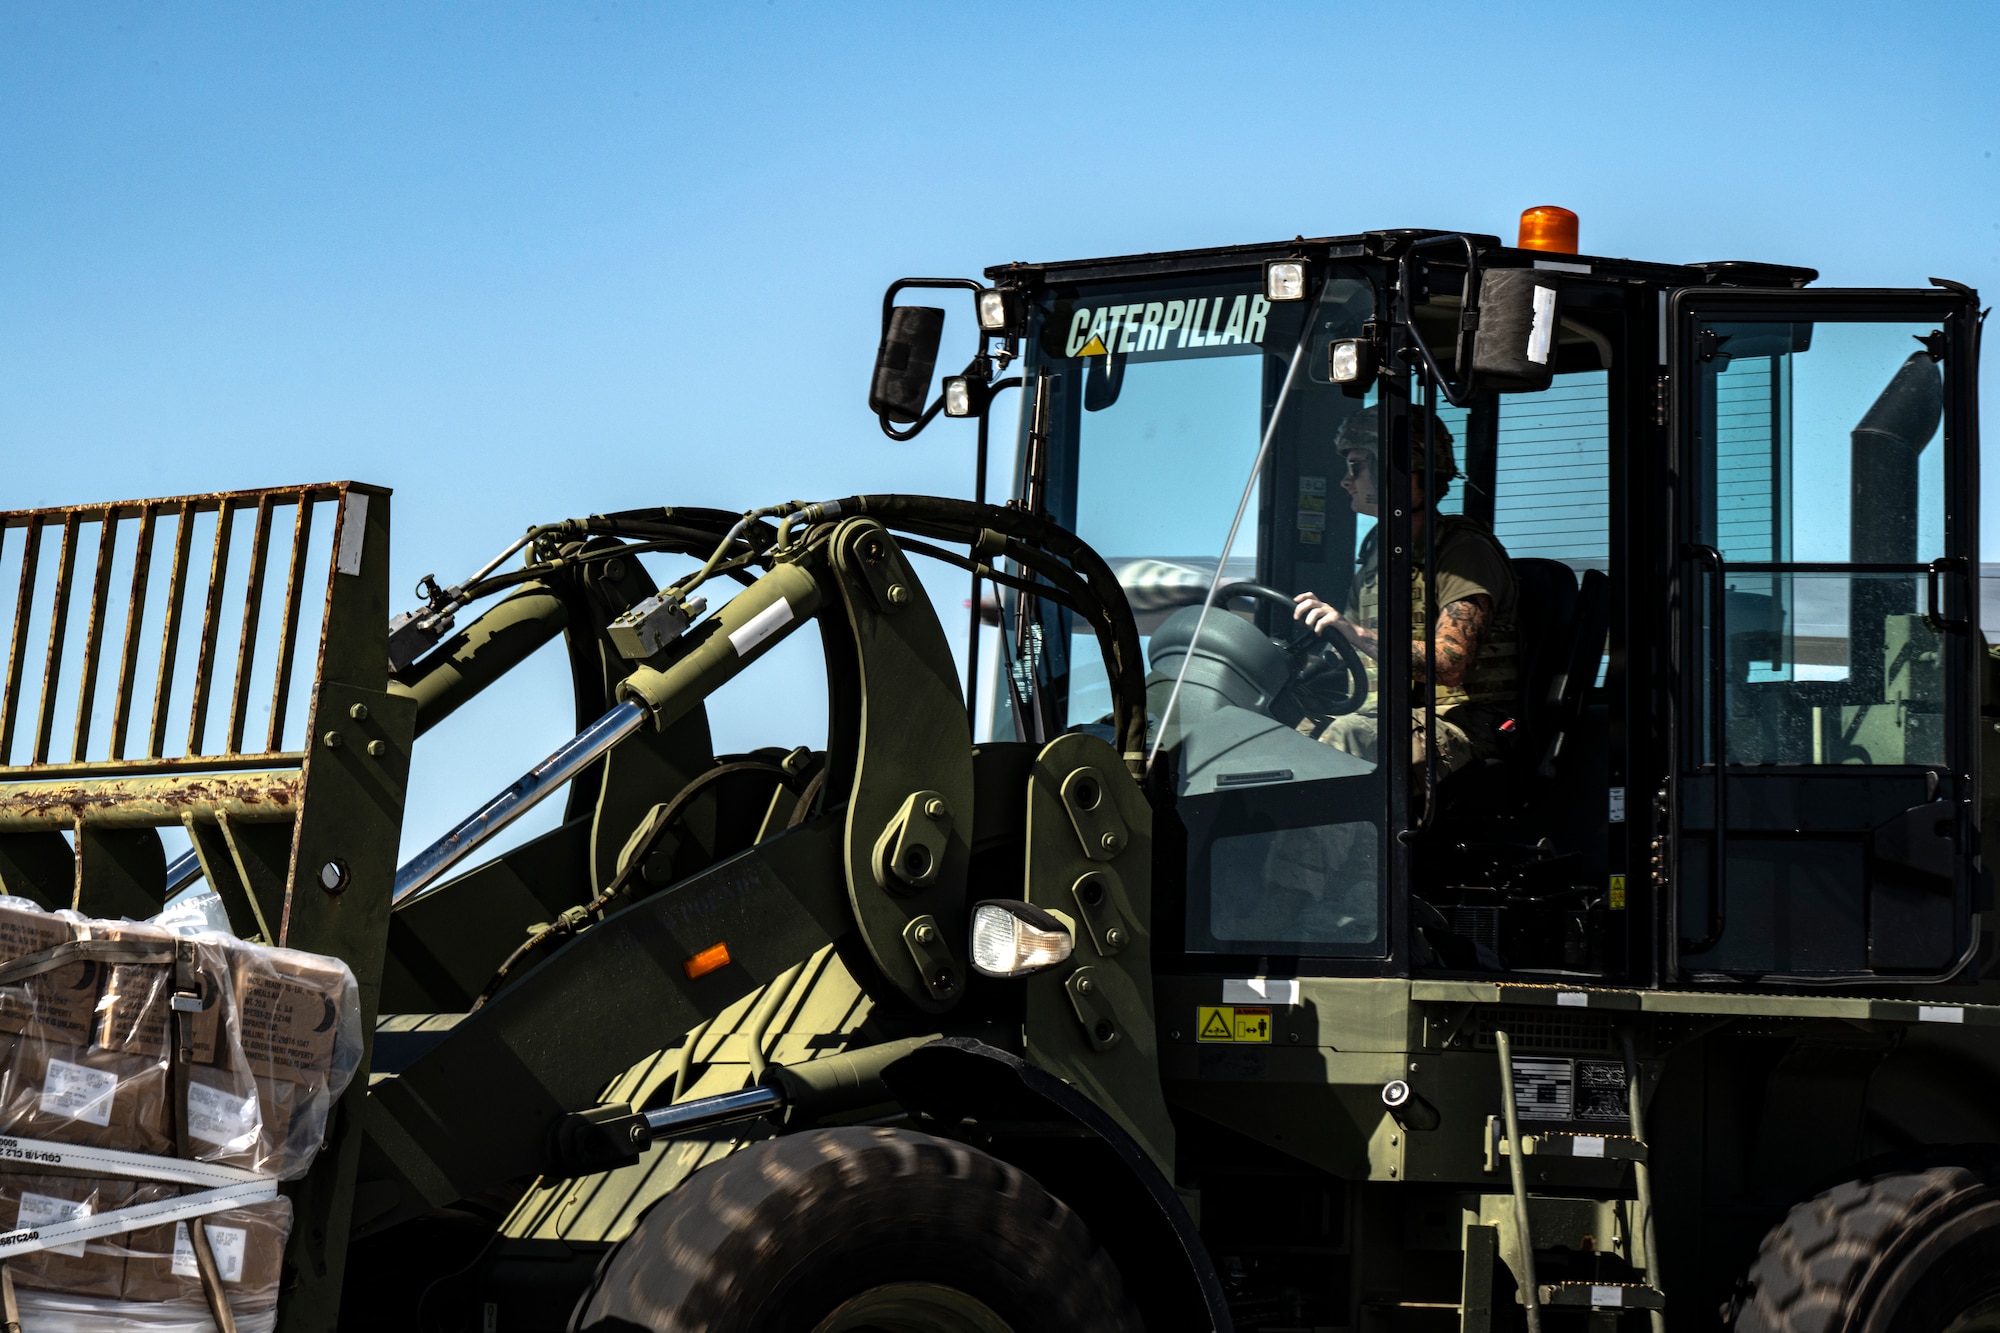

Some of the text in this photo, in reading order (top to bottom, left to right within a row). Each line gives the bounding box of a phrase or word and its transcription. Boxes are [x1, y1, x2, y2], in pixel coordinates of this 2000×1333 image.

[1065, 293, 1272, 358] CATERPILLAR
[6, 1148, 23, 1158] CL2
[25, 1151, 61, 1163] CGU-1/B
